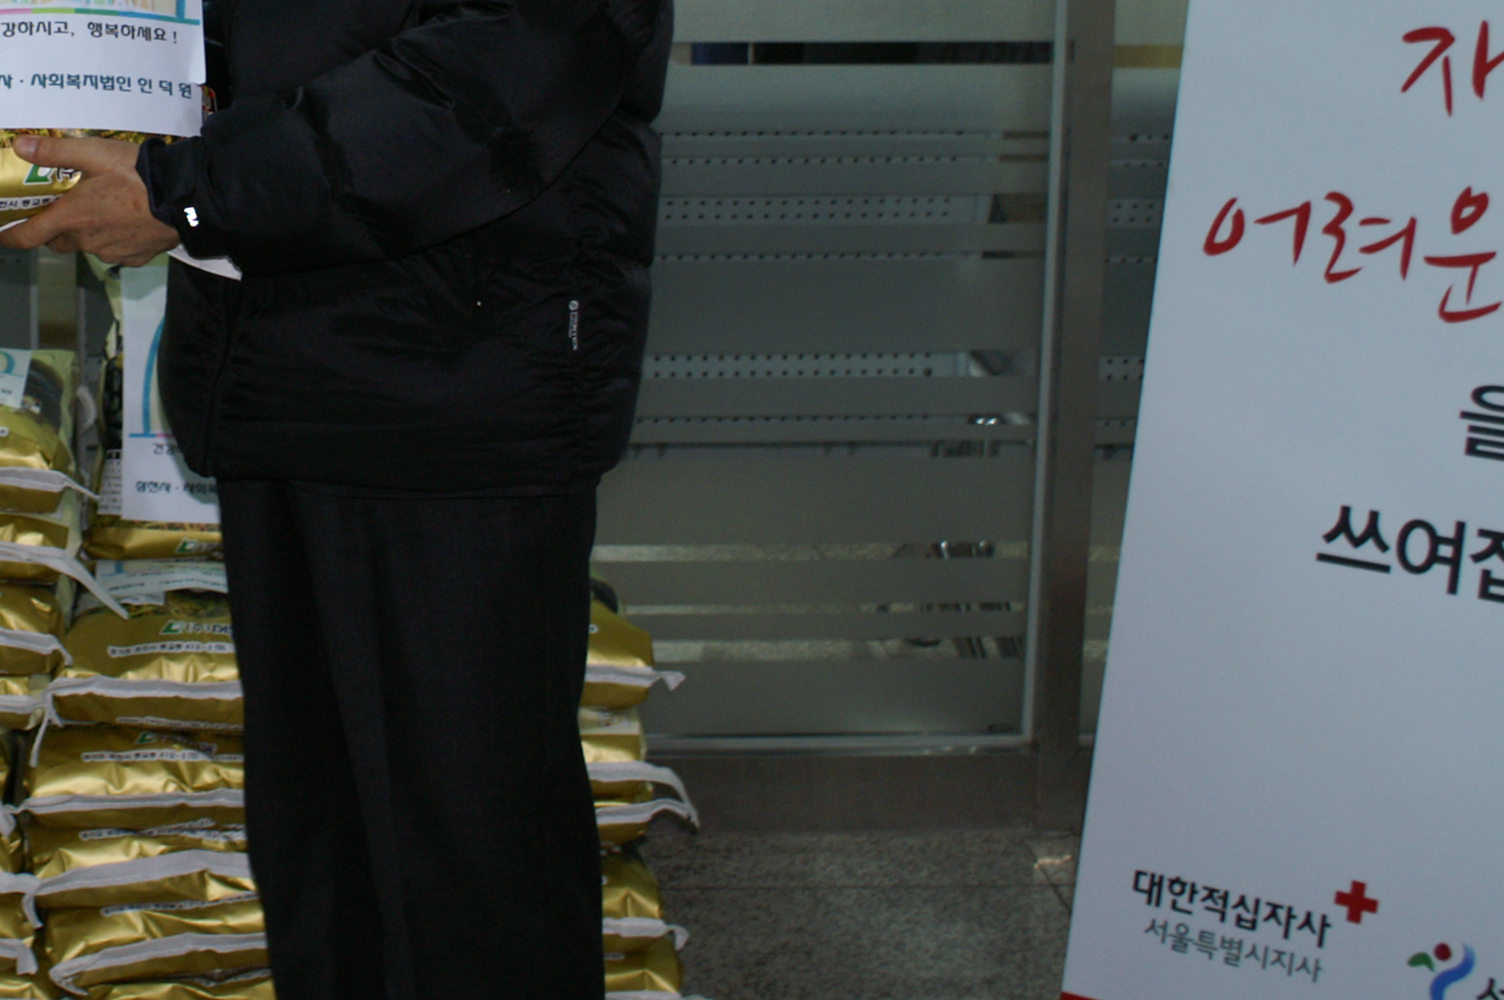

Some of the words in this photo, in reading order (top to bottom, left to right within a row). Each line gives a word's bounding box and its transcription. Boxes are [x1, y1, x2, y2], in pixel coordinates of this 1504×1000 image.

[30, 72, 133, 93] 사회복지법인
[1202, 185, 1503, 324] 어려운
[1132, 869, 1332, 949] 대한적십자사
[1144, 917, 1323, 983] 서울특별시지사
